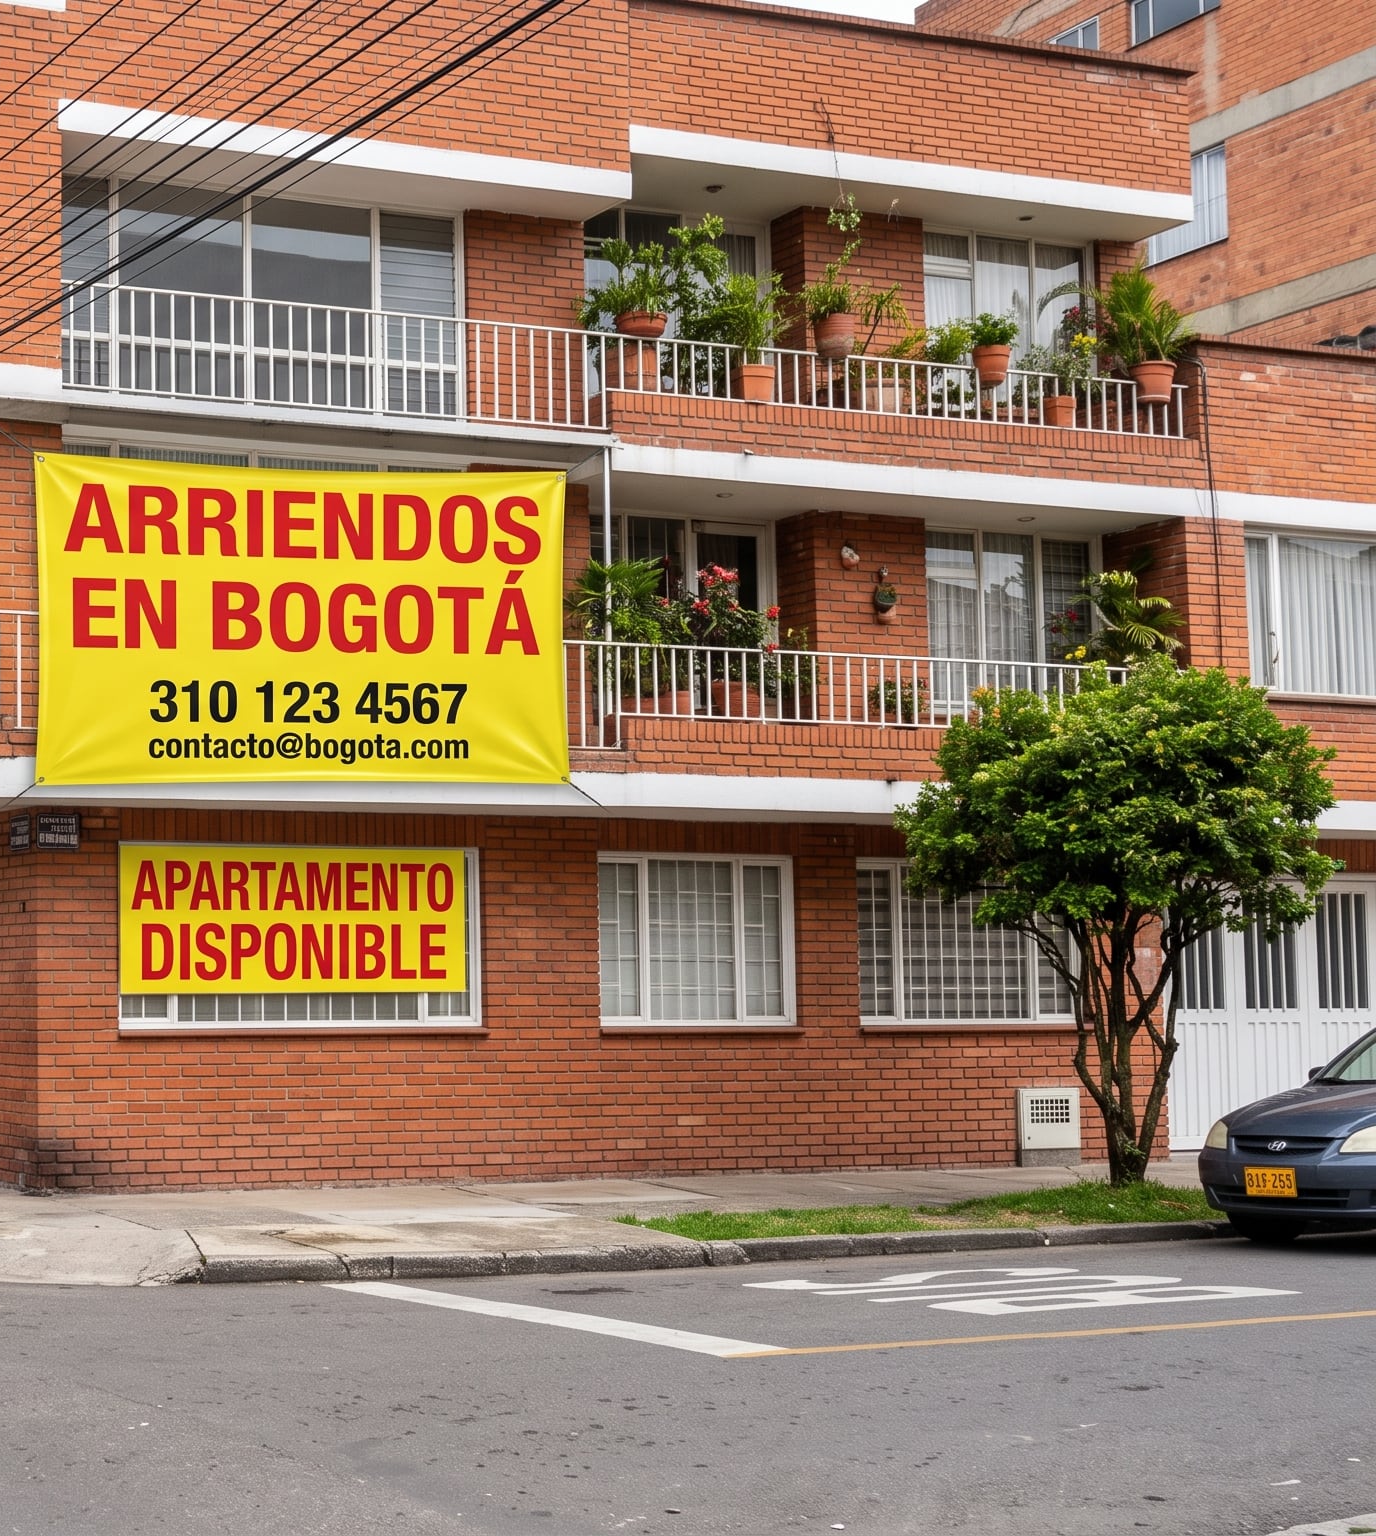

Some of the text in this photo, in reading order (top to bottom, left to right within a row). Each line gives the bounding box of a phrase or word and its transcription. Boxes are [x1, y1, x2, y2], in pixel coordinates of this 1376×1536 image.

[64, 484, 541, 565] ARRIENDOS
[72, 570, 540, 656] EN BOGOTÁ
[149, 679, 468, 725] 310 123 4567
[148, 732, 469, 765] contacto@bogota.com
[131, 860, 454, 912] APARTAMENTO
[141, 922, 447, 981] DISPONIBLE
